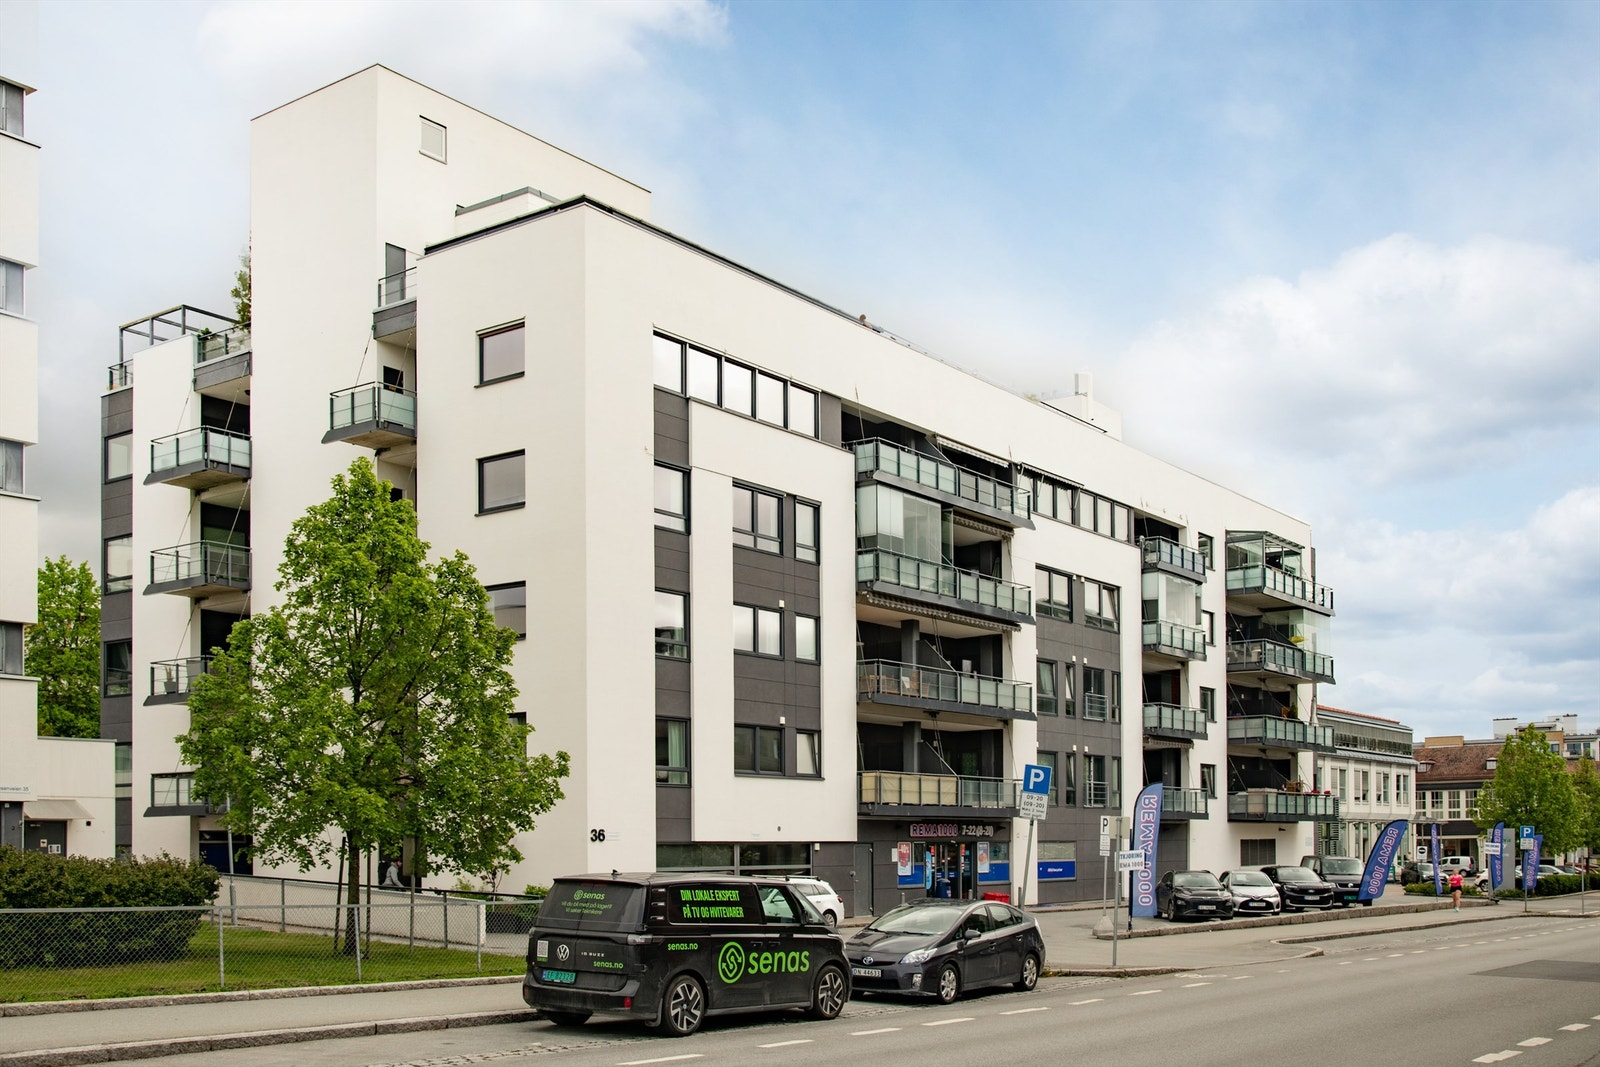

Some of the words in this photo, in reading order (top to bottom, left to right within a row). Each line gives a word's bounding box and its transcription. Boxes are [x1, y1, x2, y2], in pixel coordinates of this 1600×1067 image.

[1029, 768, 1045, 790] P
[910, 823, 937, 837] REMA
[937, 823, 959, 837] 1000
[1103, 818, 1109, 832] P
[590, 828, 606, 843] 36
[1523, 827, 1531, 838] P
[583, 892, 606, 901] senas
[680, 889, 692, 901] DIN
[692, 889, 715, 901] LOKALE
[715, 890, 740, 901] EKSPERT
[683, 904, 692, 918] PÅ
[692, 906, 700, 918] TV
[700, 906, 710, 918] OG
[710, 906, 745, 918] HVITEVARER
[667, 942, 699, 951] senas.no
[593, 960, 624, 969] senas.no
[747, 950, 810, 975] senas
